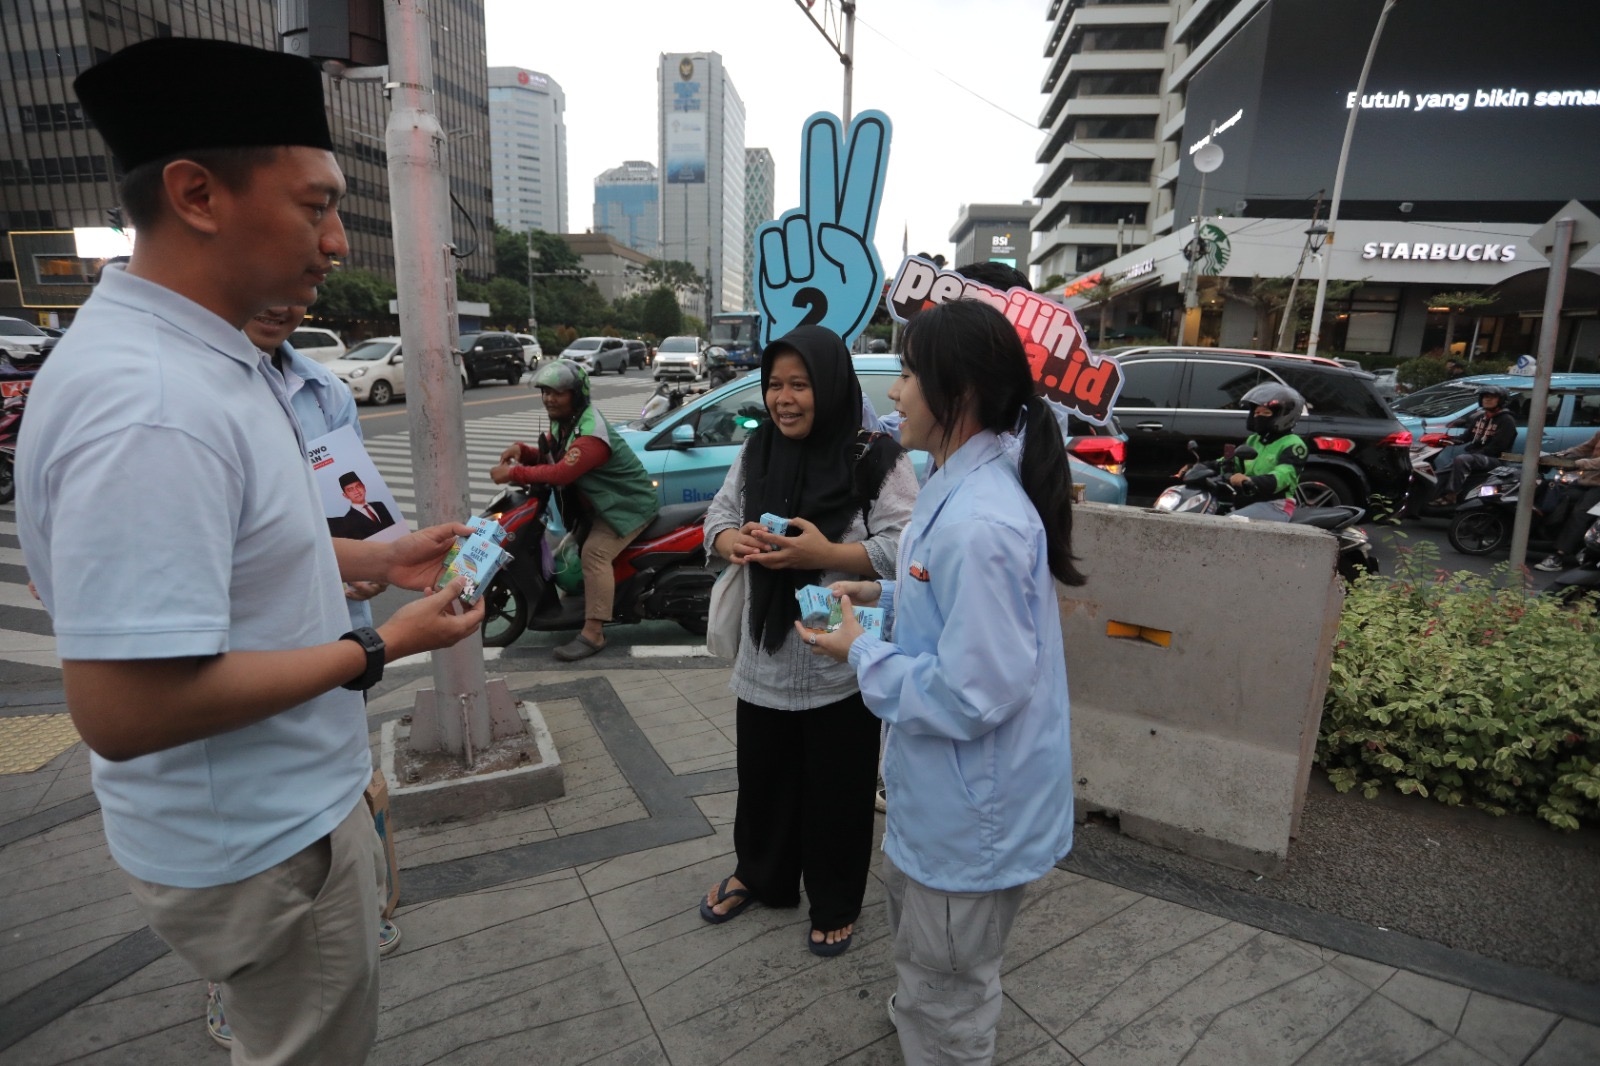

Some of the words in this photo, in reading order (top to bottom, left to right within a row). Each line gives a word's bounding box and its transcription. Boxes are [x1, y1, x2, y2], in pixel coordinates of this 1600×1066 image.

[1413, 92, 1470, 111] yang
[1474, 88, 1530, 107] bikin
[992, 236, 1008, 246] BSI
[1362, 242, 1517, 262] STARBUCKS
[792, 287, 828, 328] 2
[682, 488, 720, 503] Blue
